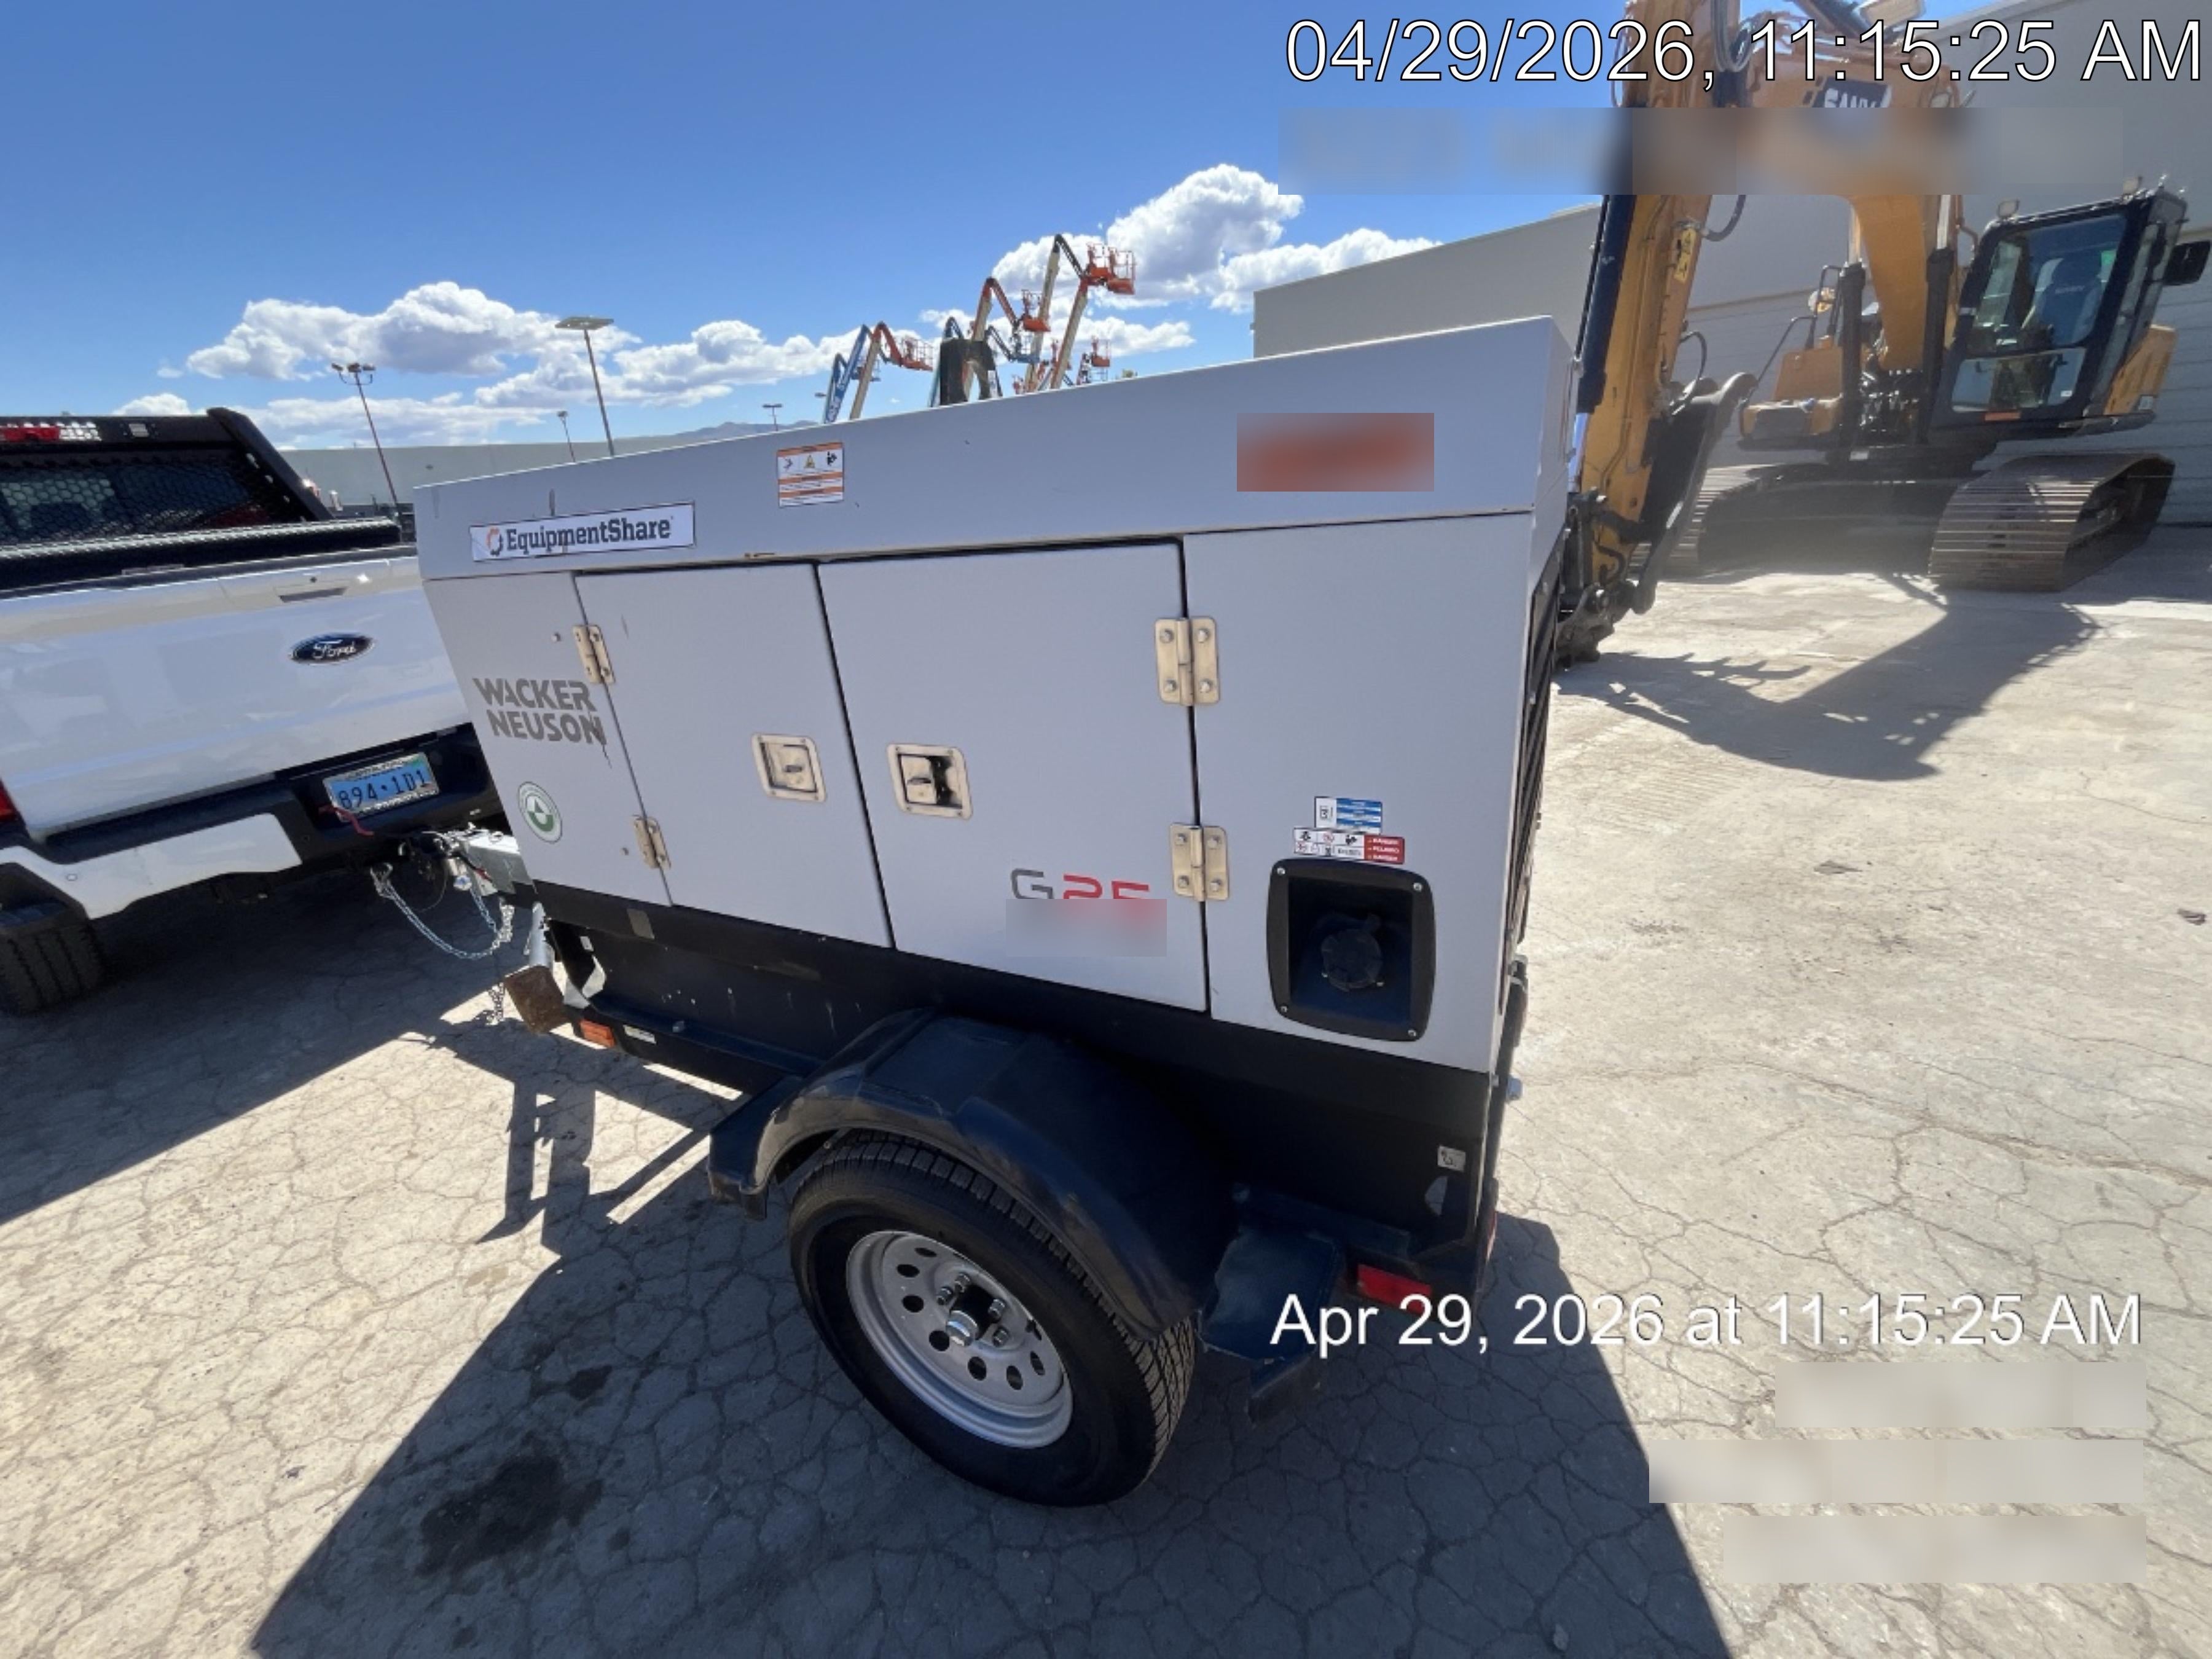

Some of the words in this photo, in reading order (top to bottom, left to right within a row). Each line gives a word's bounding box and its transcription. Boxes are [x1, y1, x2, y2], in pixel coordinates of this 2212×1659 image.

[506, 517, 672, 555] EquipmentShare
[312, 638, 356, 659] Ford
[472, 678, 597, 712] WACKER
[486, 708, 607, 745] NEUSON
